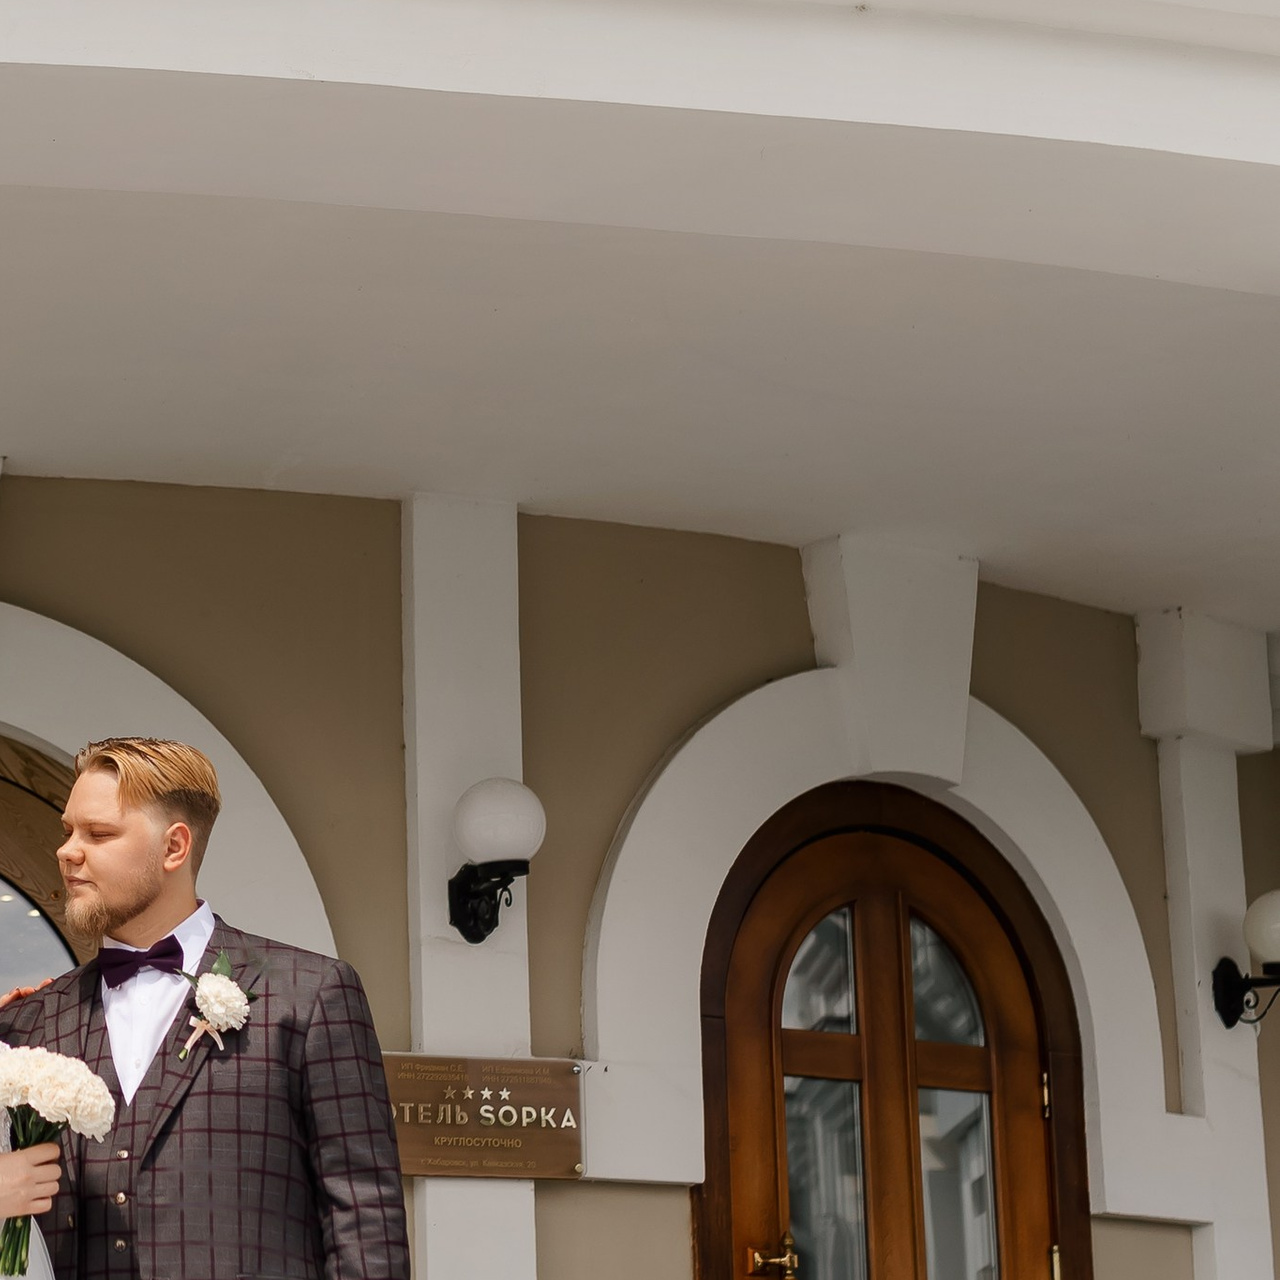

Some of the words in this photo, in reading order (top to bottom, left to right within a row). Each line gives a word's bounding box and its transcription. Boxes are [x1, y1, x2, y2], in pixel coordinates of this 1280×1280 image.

[391, 1102, 469, 1125] ТЕЛЬ
[479, 1104, 577, 1129] SOPKA
[434, 1136, 522, 1148] КРУГЛОСУТОЧНО
